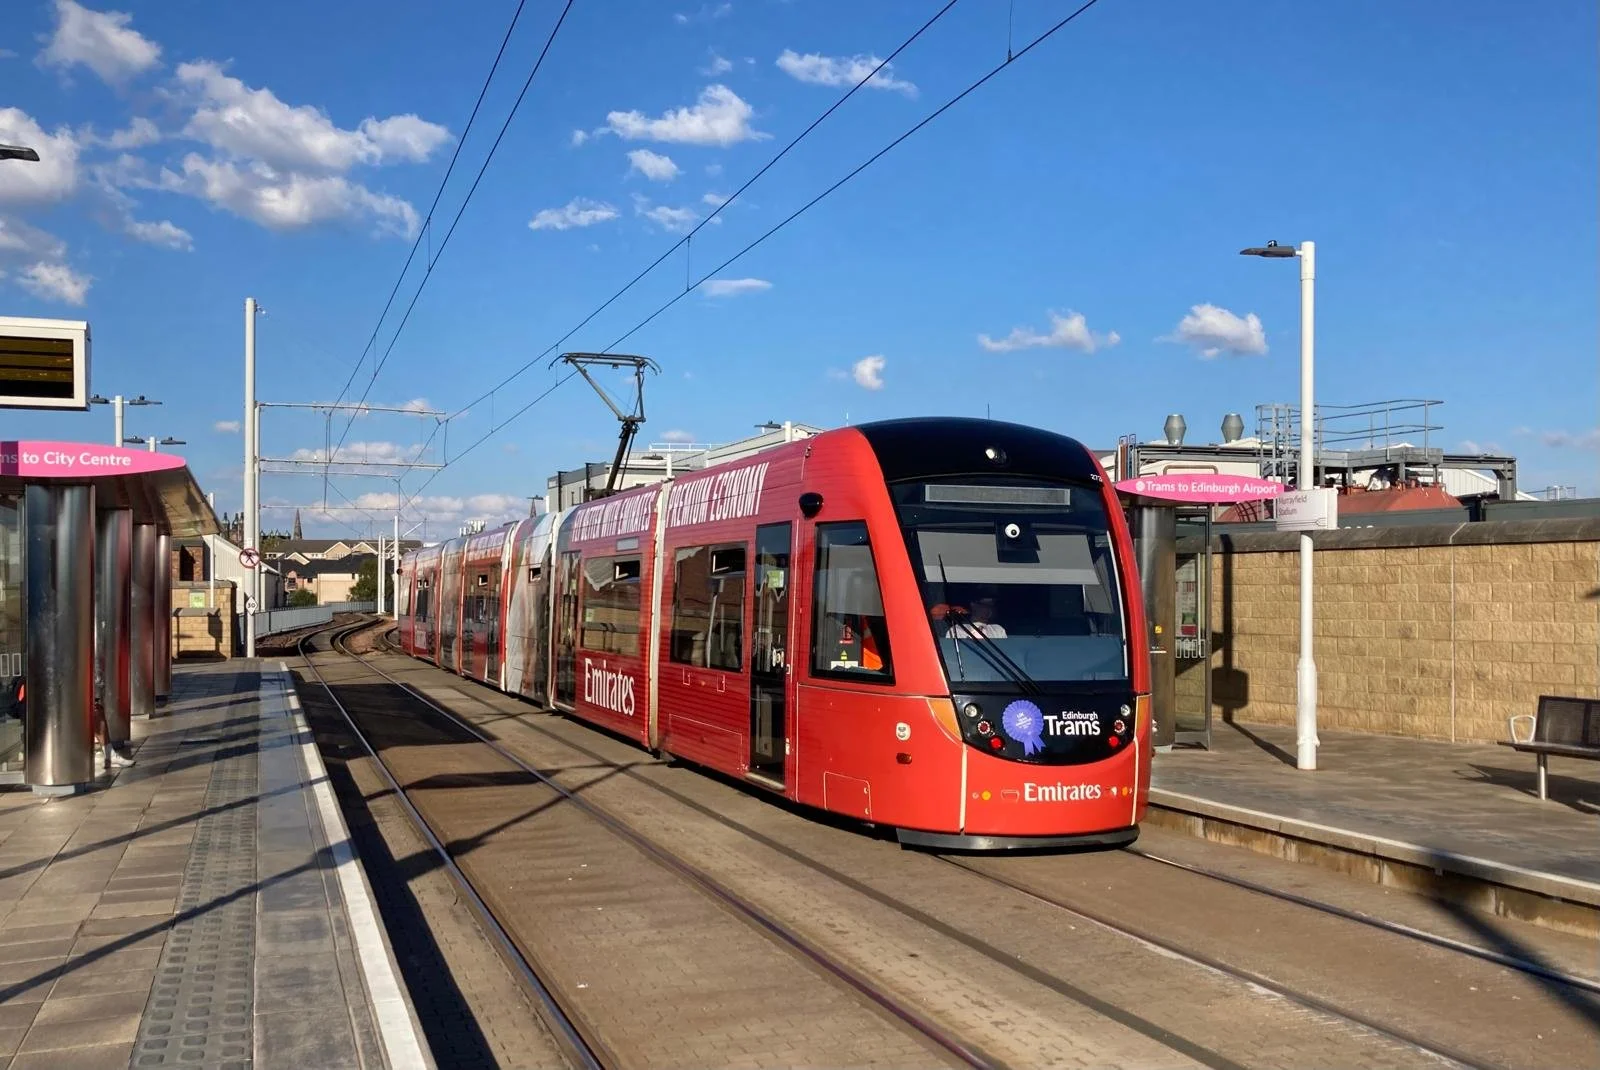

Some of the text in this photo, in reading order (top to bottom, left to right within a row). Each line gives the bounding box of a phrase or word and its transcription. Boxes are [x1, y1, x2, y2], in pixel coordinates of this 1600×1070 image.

[22, 452, 39, 465] to
[43, 451, 76, 468] City
[79, 452, 131, 467] Centre
[617, 490, 656, 535] EMIRATES
[665, 476, 716, 529] PREMIUM
[710, 462, 769, 520] ECONOMY
[1146, 480, 1277, 497] Trams to Edinburgh Airport
[584, 657, 635, 717] Emirates
[1043, 715, 1101, 736] Trams
[1062, 711, 1098, 721] Edinburgh
[1023, 782, 1102, 802] Emirates
